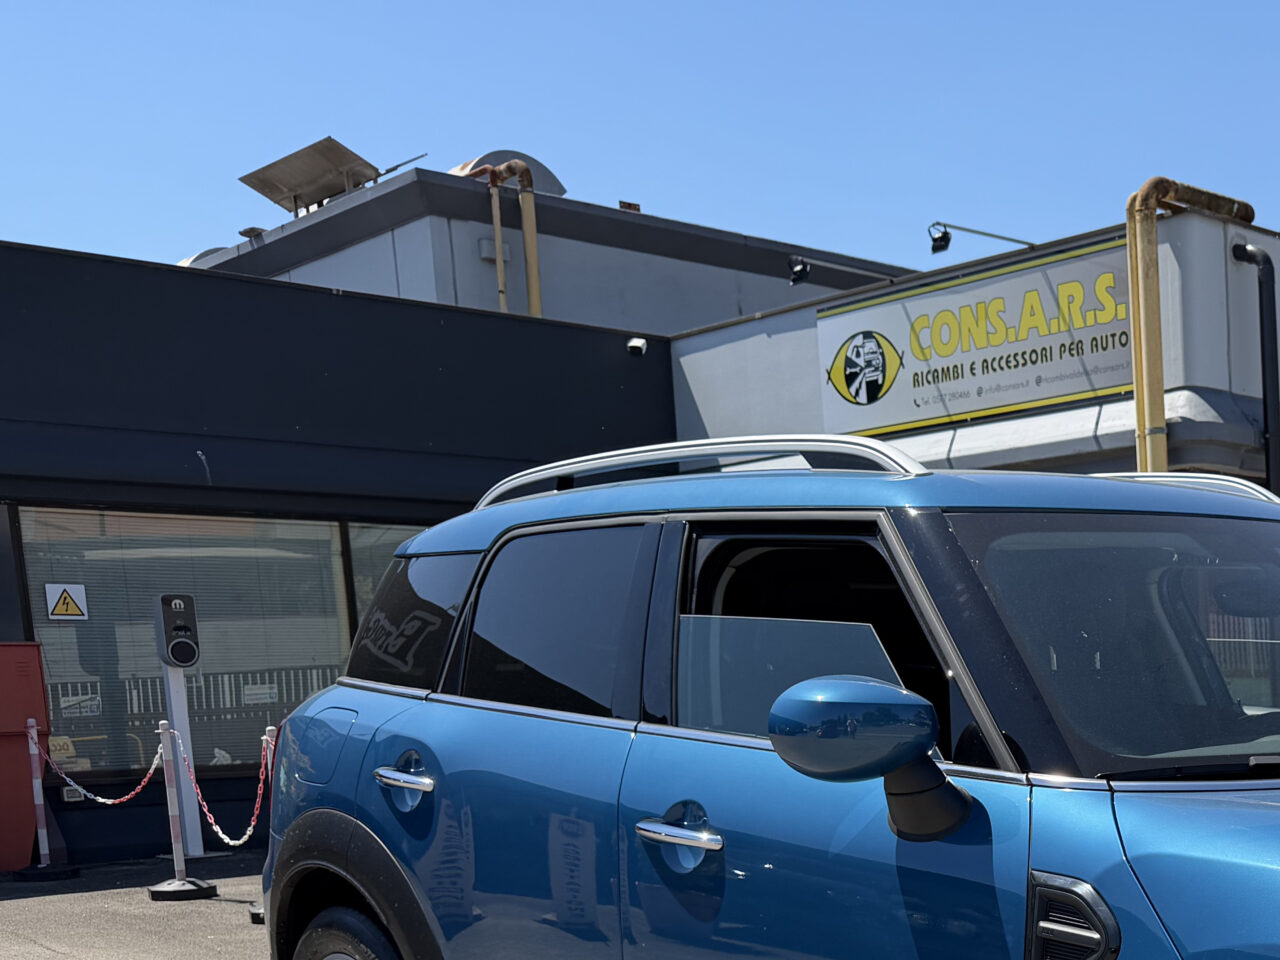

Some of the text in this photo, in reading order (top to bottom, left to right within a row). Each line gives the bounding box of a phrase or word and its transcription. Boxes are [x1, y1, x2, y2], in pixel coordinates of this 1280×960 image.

[909, 272, 1127, 362] CONS.A.R.S.
[912, 330, 1130, 388] RICAMBI E ACCESSORI PER AUTO
